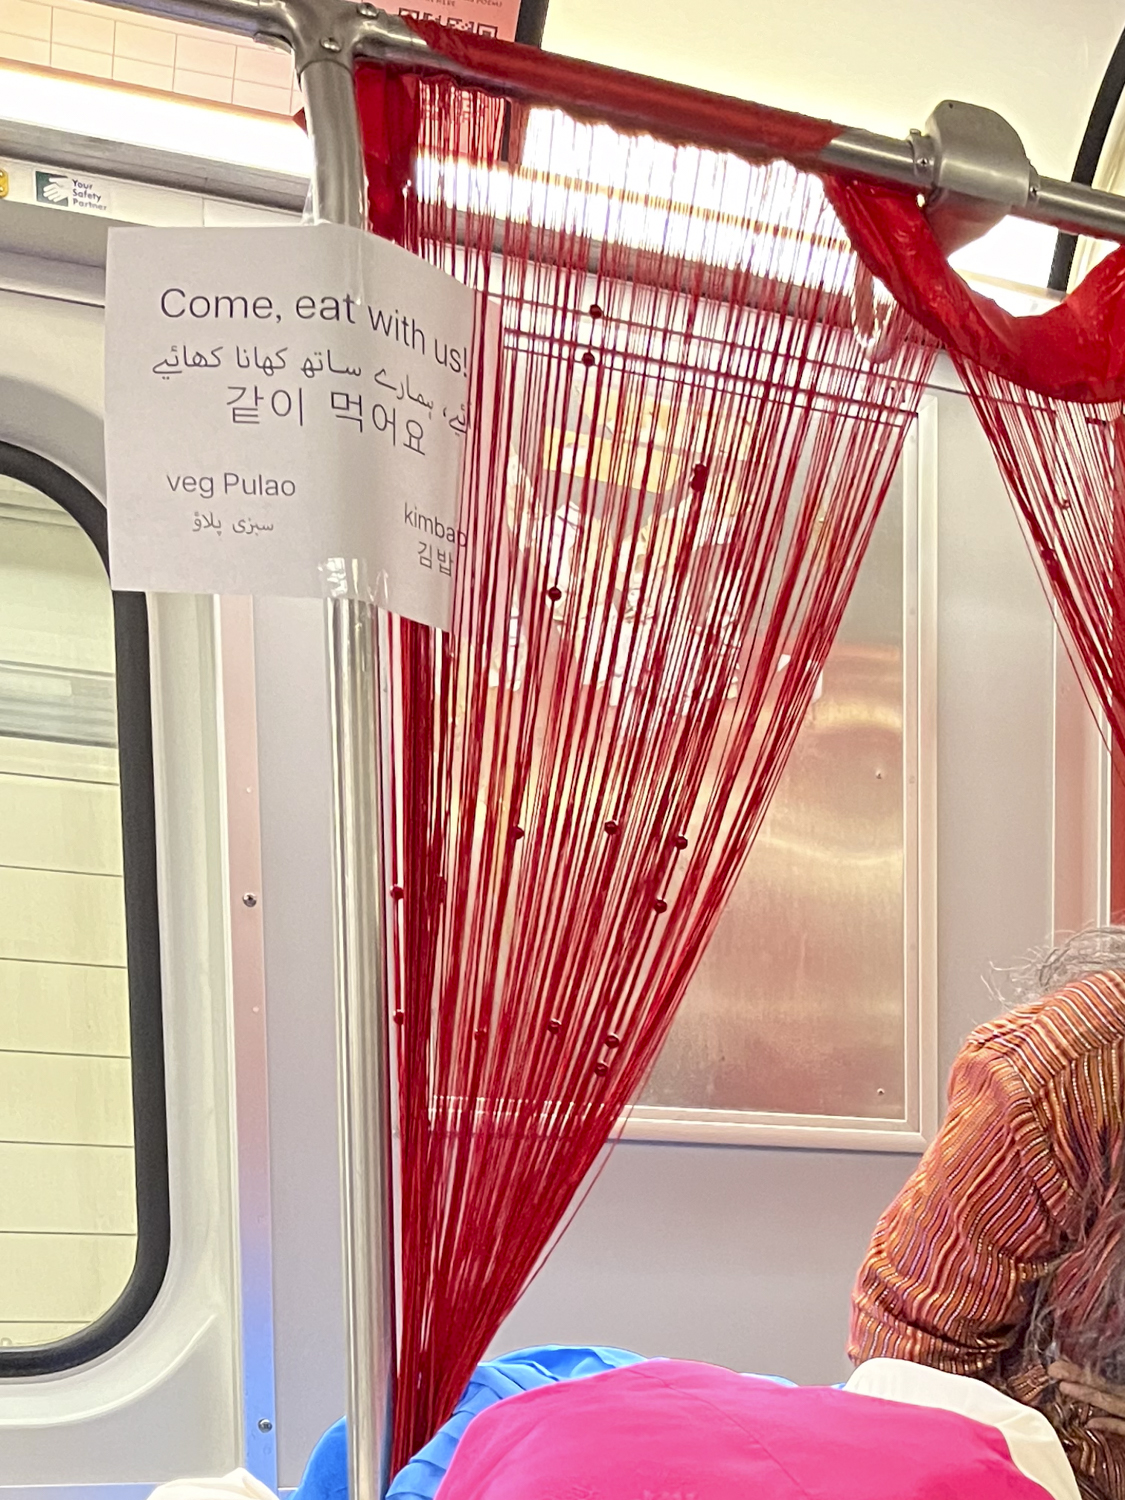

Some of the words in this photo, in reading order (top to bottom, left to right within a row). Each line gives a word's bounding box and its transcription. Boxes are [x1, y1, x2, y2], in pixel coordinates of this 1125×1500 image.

[72, 179, 93, 190] Your
[72, 188, 102, 203] Safety
[72, 198, 107, 211] Partner
[160, 287, 282, 324] Come,
[295, 293, 356, 325] eat
[367, 305, 425, 355] with
[434, 338, 468, 378] us!
[152, 344, 224, 381] کھائیے
[235, 345, 289, 377] کھانا
[300, 349, 362, 379] ساتھ
[373, 367, 434, 421] ہمارے
[226, 385, 304, 427] 같이
[330, 391, 426, 456] 먹어요
[166, 474, 214, 499] veg
[223, 472, 296, 497] Pulao
[192, 511, 222, 537] پلاؤ
[232, 517, 275, 537] سبزی
[404, 501, 468, 550] kimbap
[417, 541, 454, 577] 김밥
